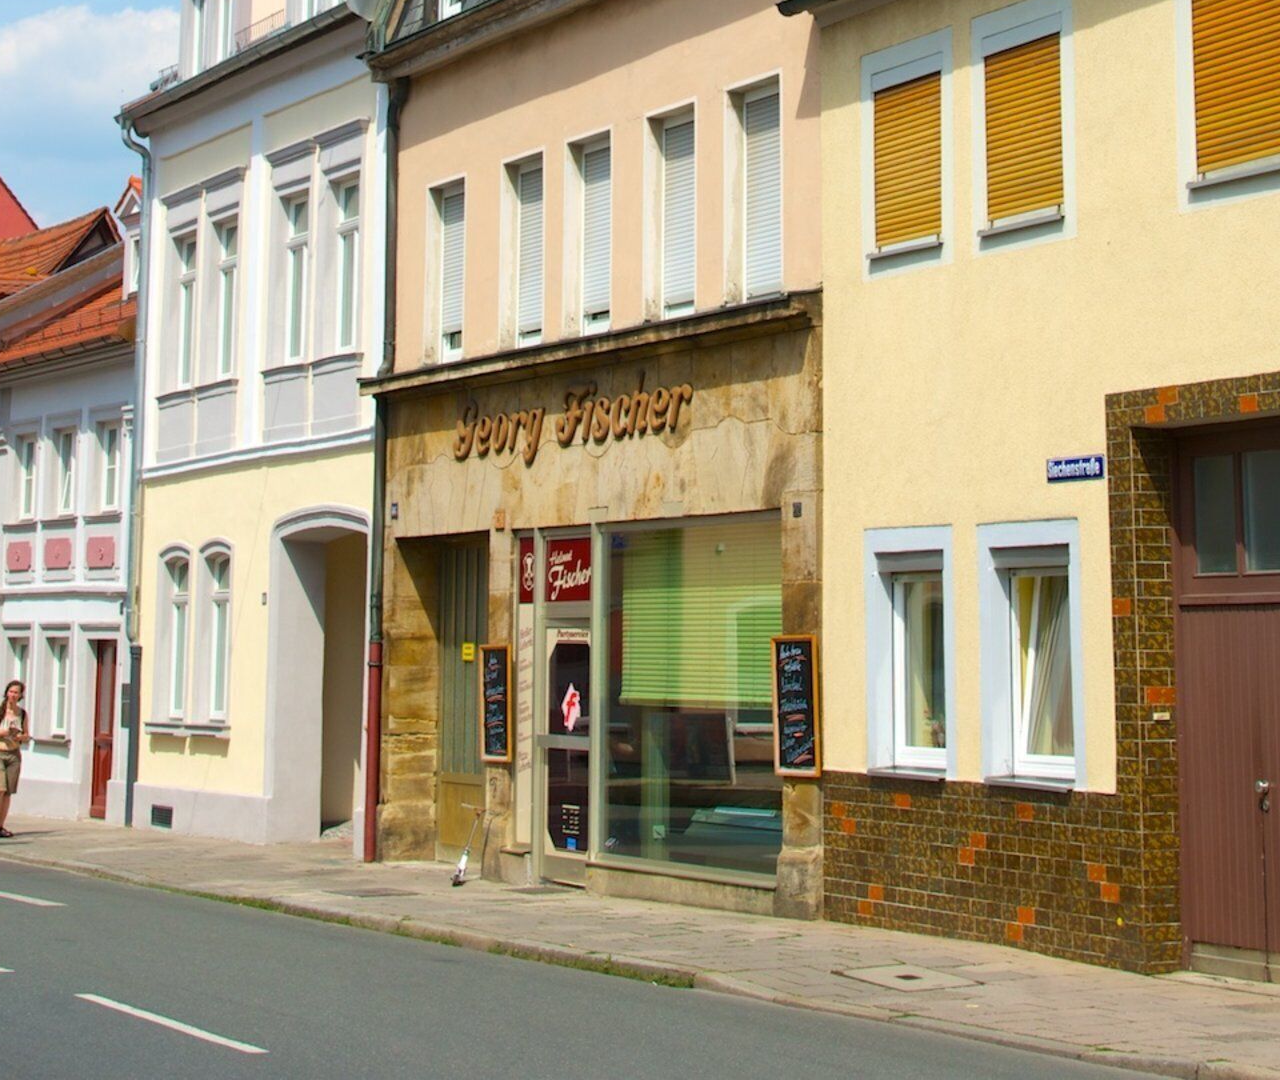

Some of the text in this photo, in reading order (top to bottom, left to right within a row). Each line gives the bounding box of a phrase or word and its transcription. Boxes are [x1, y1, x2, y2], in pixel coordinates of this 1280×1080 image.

[453, 372, 694, 468] Georg Fischer
[548, 559, 592, 601] Fischer
